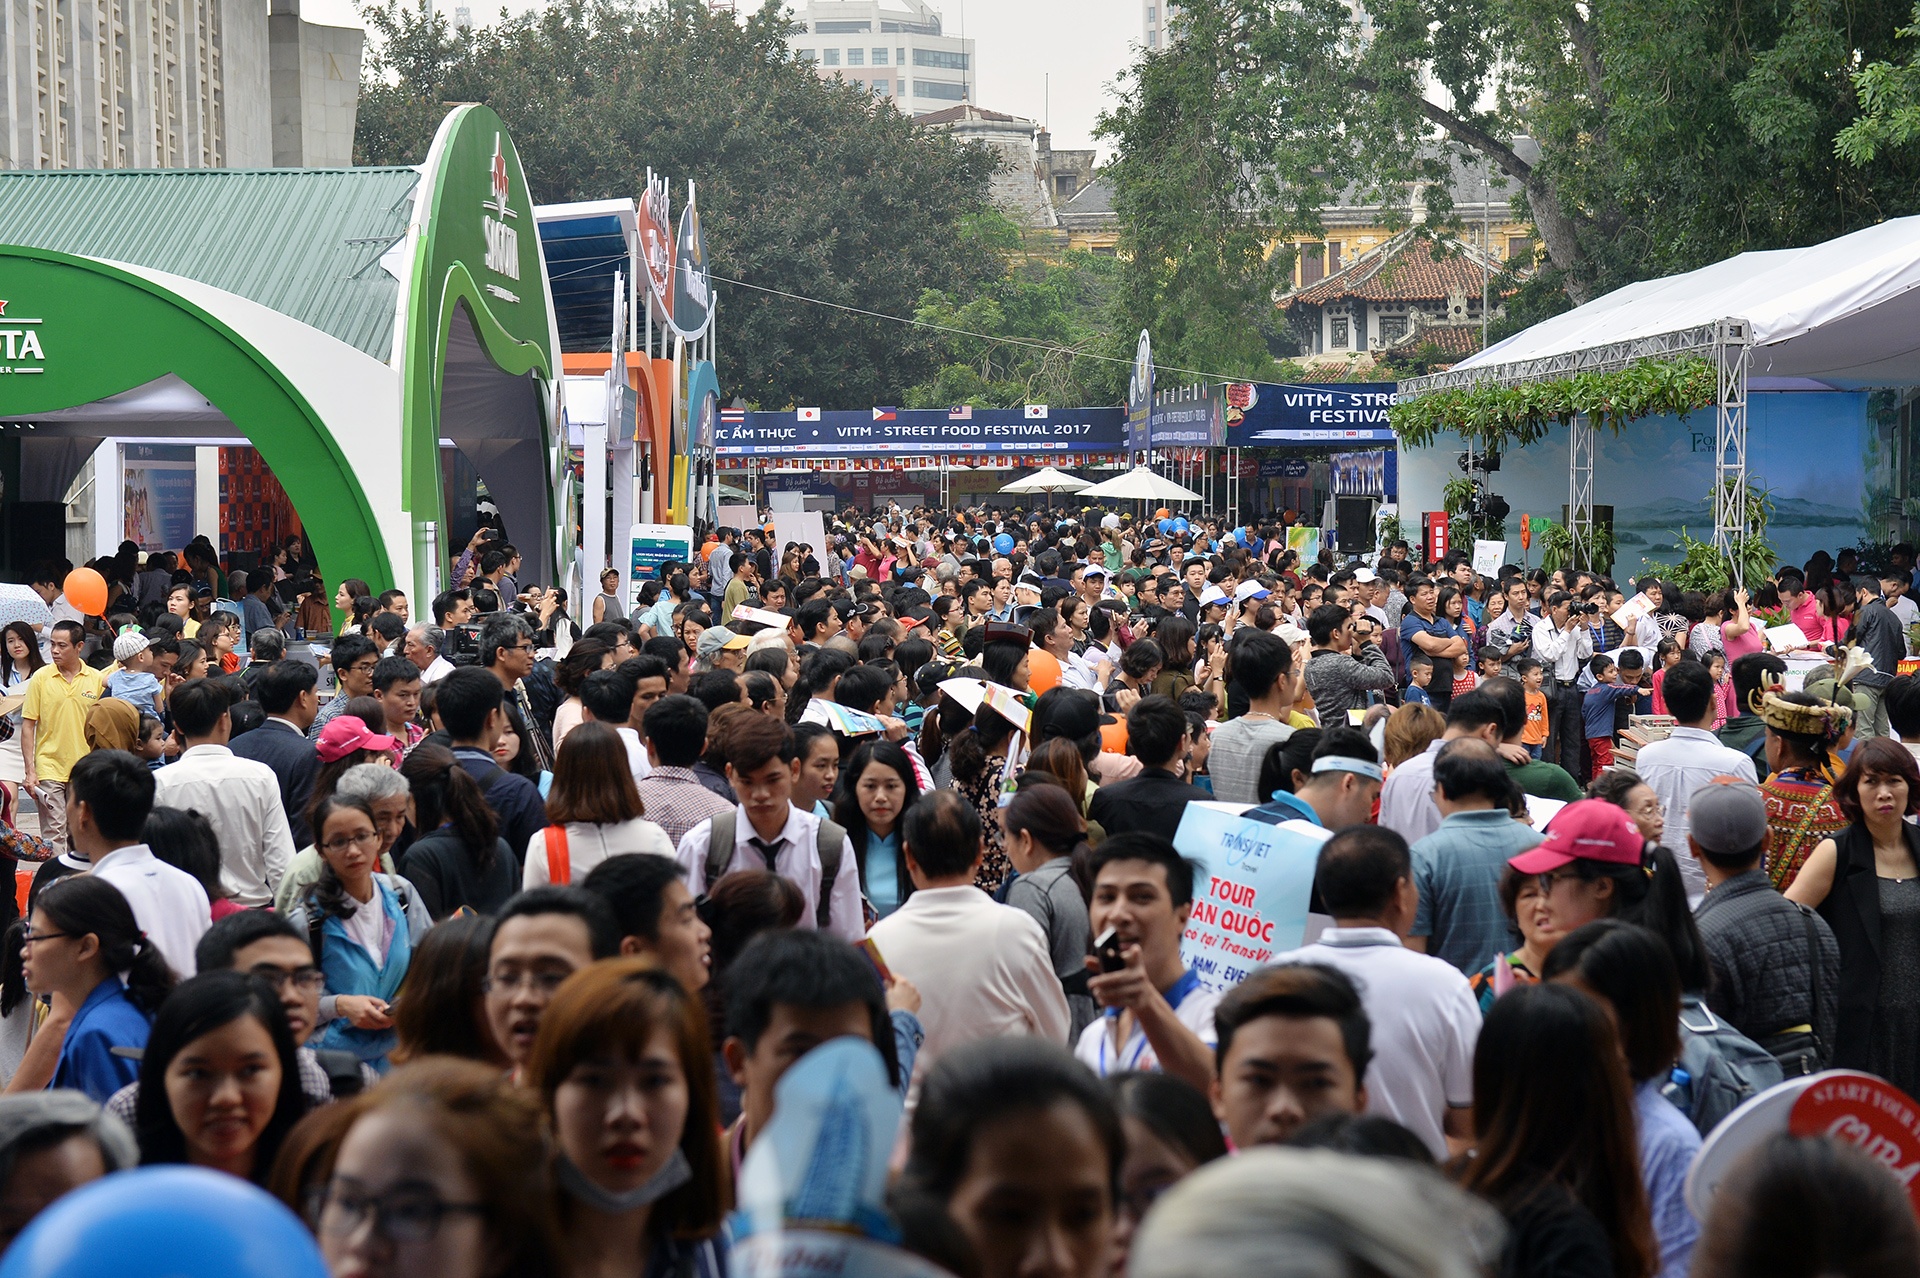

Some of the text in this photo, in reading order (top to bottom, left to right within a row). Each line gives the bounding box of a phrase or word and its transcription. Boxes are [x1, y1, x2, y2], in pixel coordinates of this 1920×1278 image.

[0, 330, 45, 360] TA
[1284, 393, 1333, 407] VITM
[732, 424, 754, 439] ẨM
[758, 428, 797, 441] THỰC
[836, 426, 872, 437] VITM
[884, 425, 938, 436] STREET
[941, 425, 980, 436] FOOD
[984, 424, 1050, 435] FESTIVAL
[1053, 424, 1091, 435] 2017
[1209, 876, 1256, 908] TOUR
[1190, 897, 1275, 944] ÀN QUỐC
[1200, 932, 1220, 950] tại
[1191, 955, 1218, 975] NAMI
